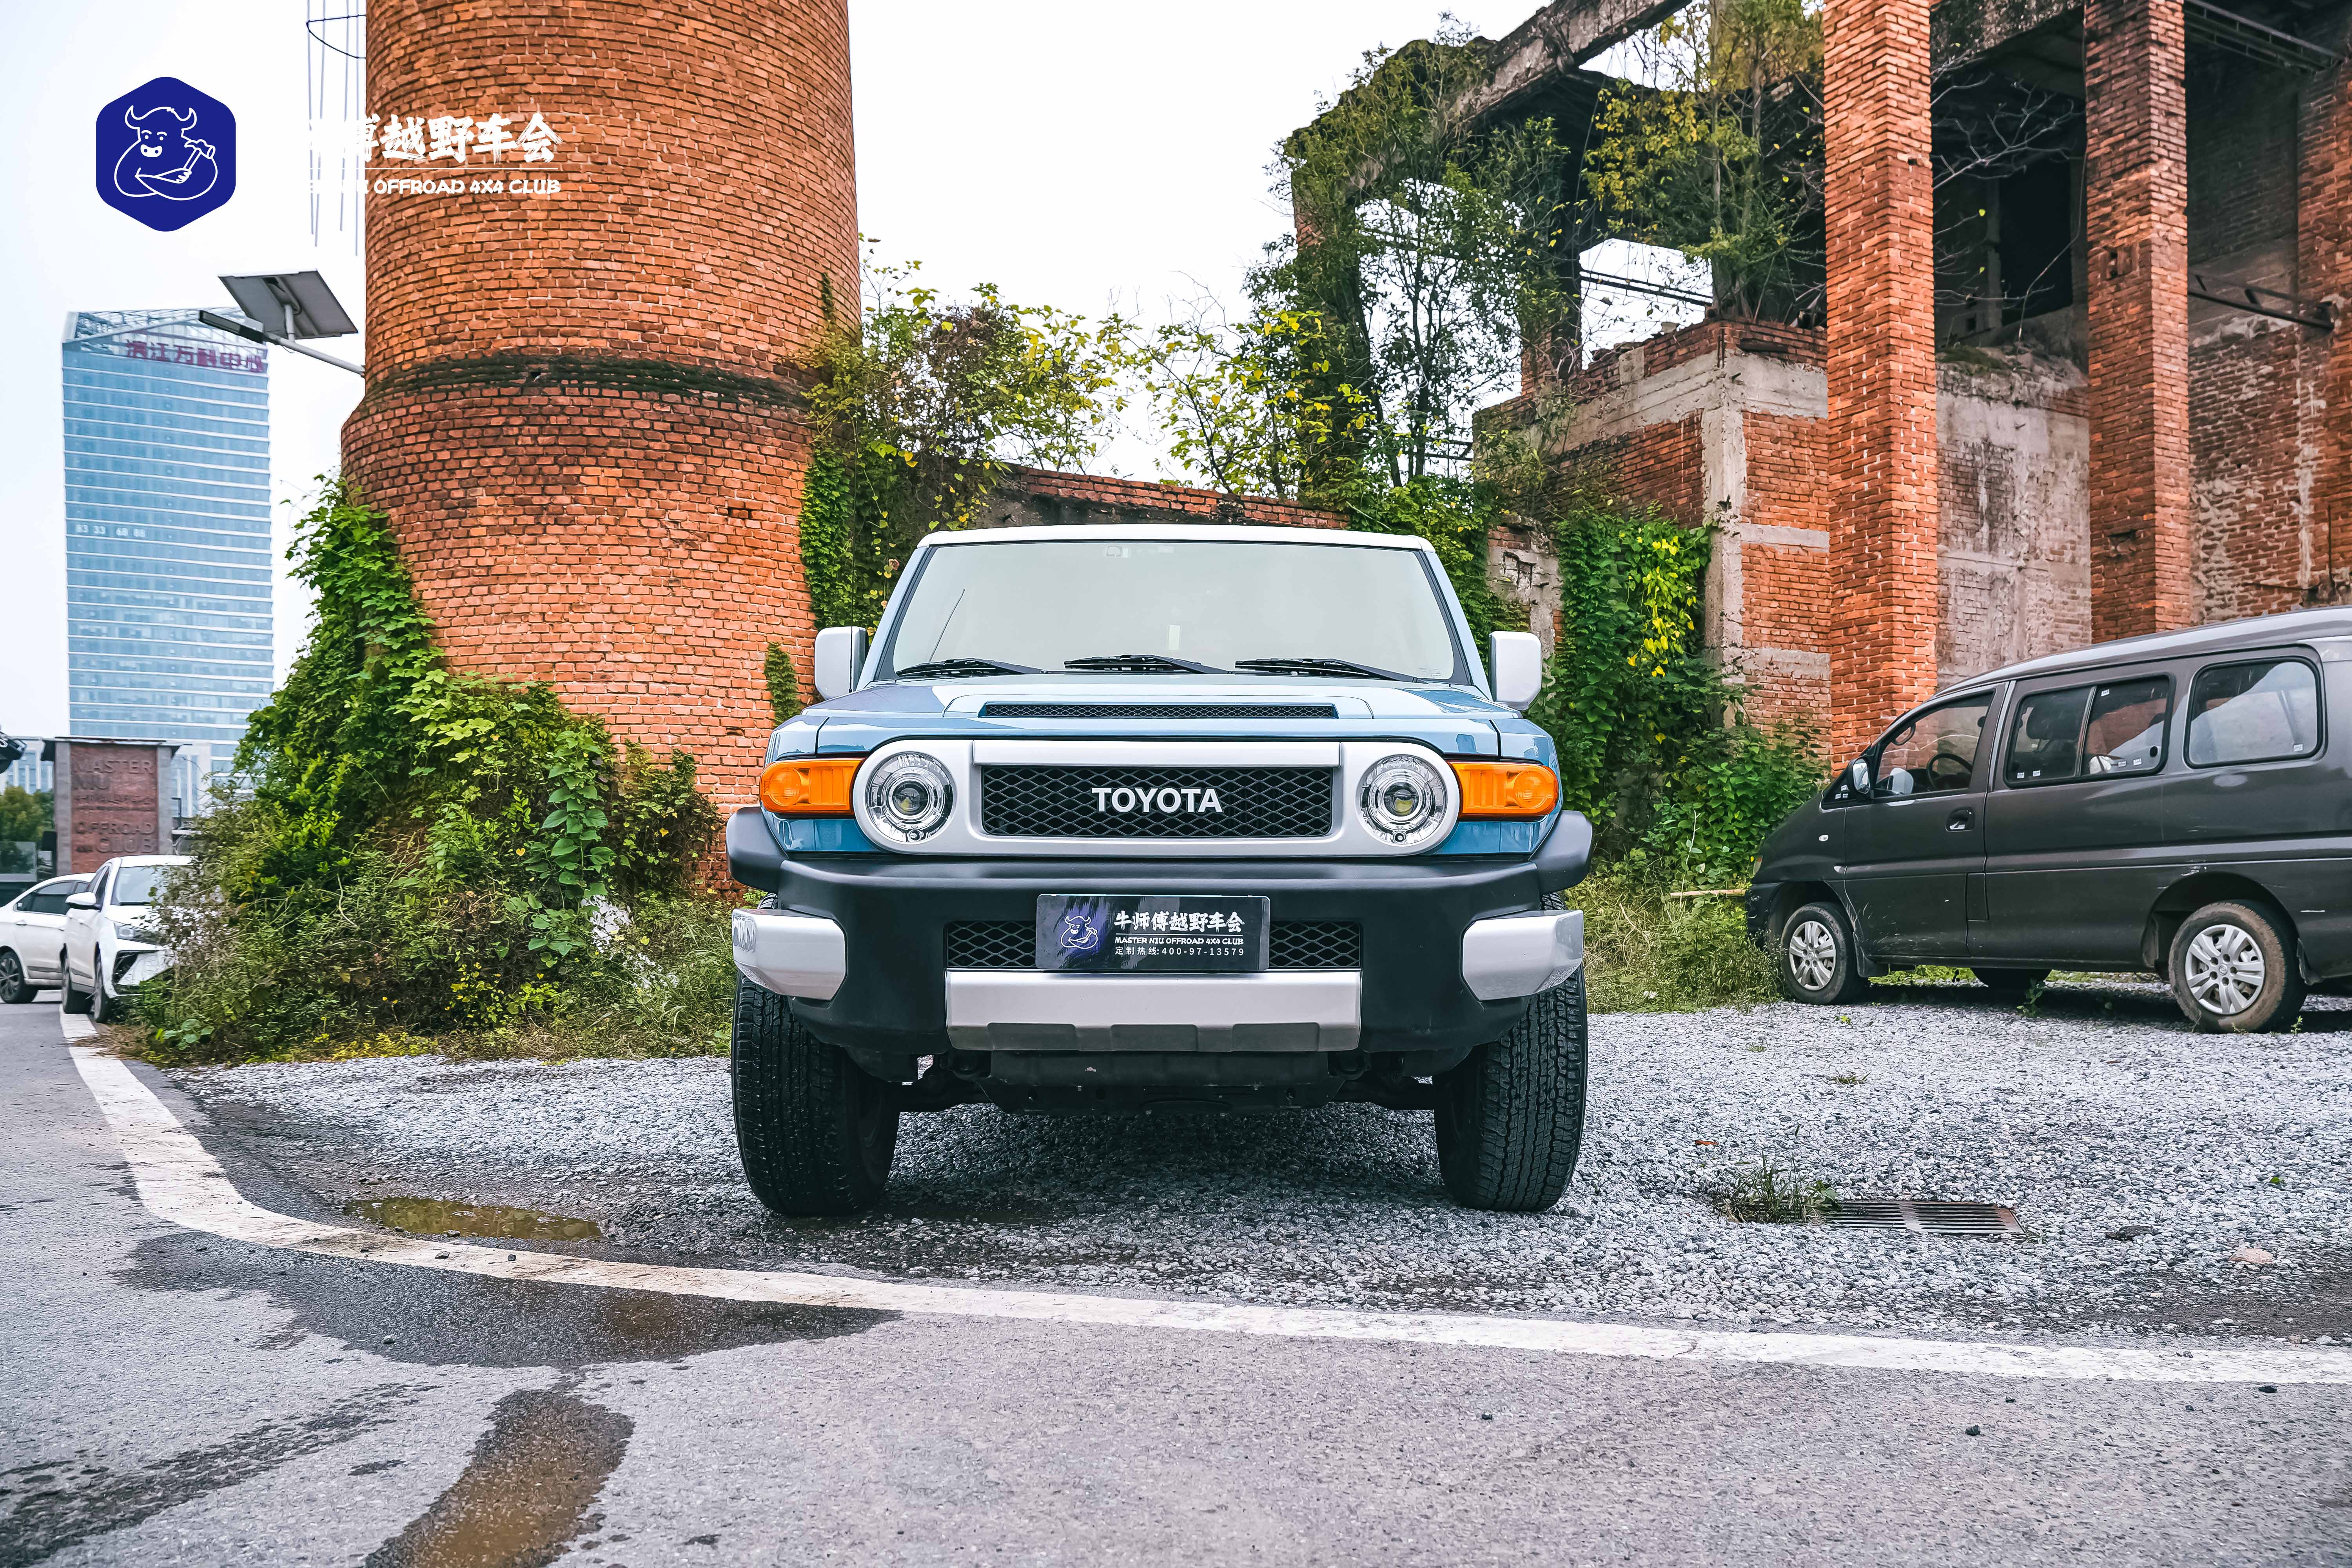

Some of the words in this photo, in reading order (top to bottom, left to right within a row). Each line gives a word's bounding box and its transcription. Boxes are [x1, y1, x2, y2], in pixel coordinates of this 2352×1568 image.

[73, 759, 154, 775] MASTER
[1091, 788, 1223, 813] TOYOTA
[1114, 910, 1245, 933] 牛师傅越野车会
